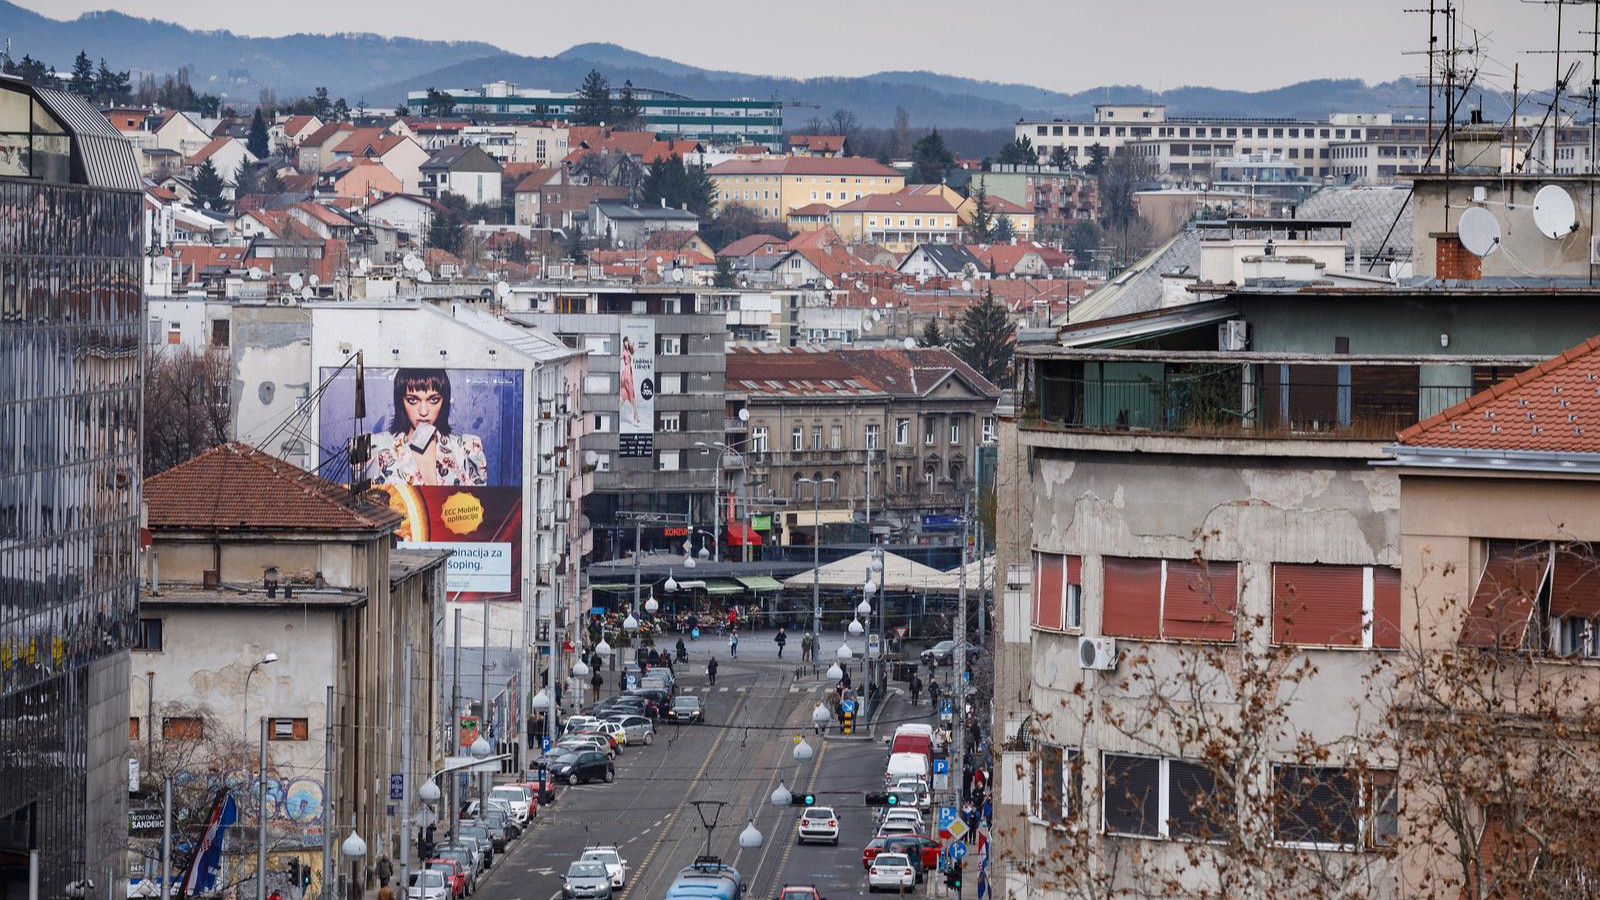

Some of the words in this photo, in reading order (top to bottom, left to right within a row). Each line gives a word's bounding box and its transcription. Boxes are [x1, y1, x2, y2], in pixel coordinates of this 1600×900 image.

[444, 508, 457, 516] ECC
[457, 505, 479, 514] Mobile
[447, 513, 478, 523] aplikacija
[451, 548, 489, 559] binacija
[490, 549, 502, 558] za
[447, 560, 483, 571] šoping.
[543, 739, 550, 750] P
[938, 762, 944, 773] P
[941, 807, 950, 820] P
